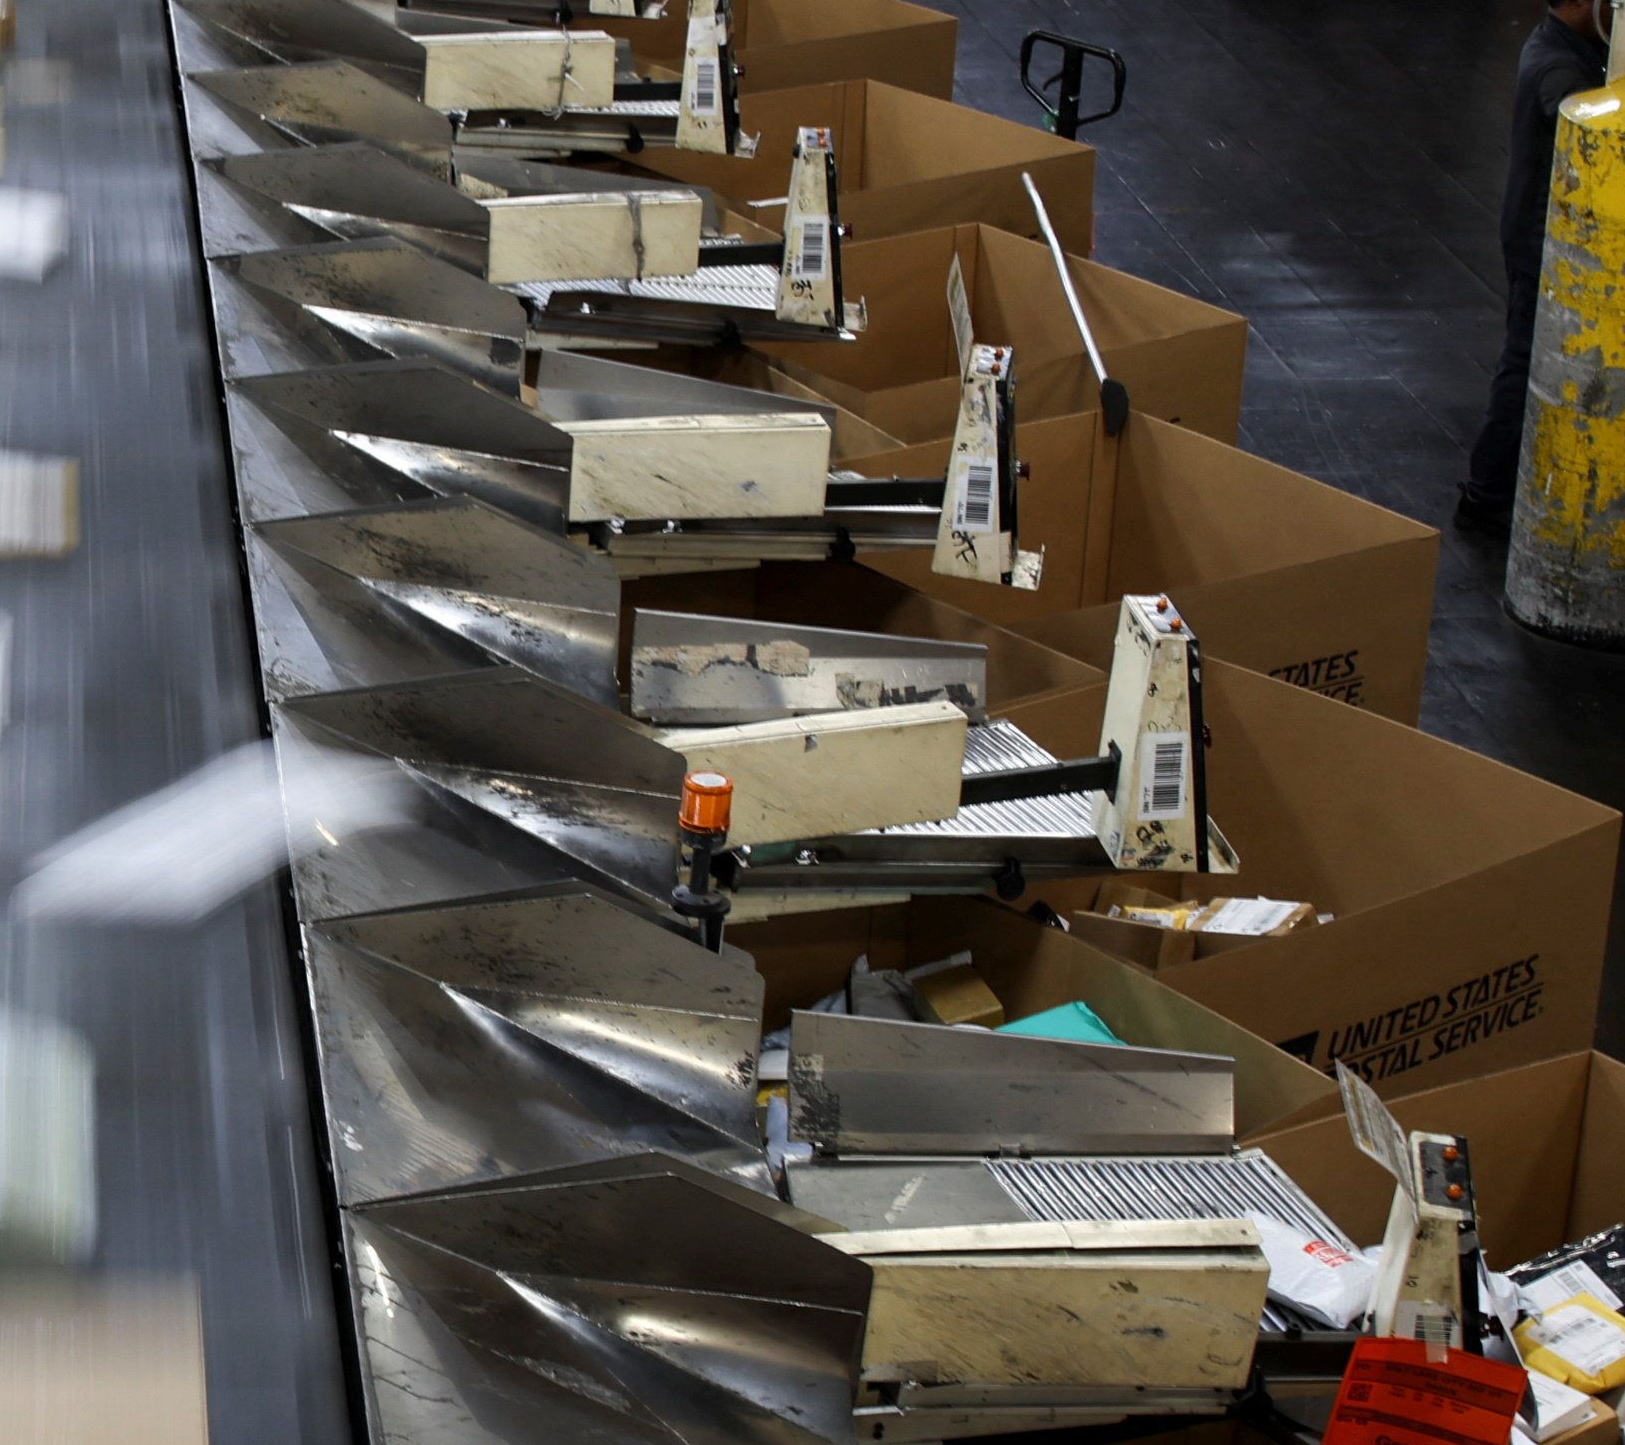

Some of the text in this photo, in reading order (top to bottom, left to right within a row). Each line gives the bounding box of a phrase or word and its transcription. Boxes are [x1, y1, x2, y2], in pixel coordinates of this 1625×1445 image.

[1327, 955, 1539, 1059] UNITED STATES
[1428, 989, 1542, 1062] SERVICE
